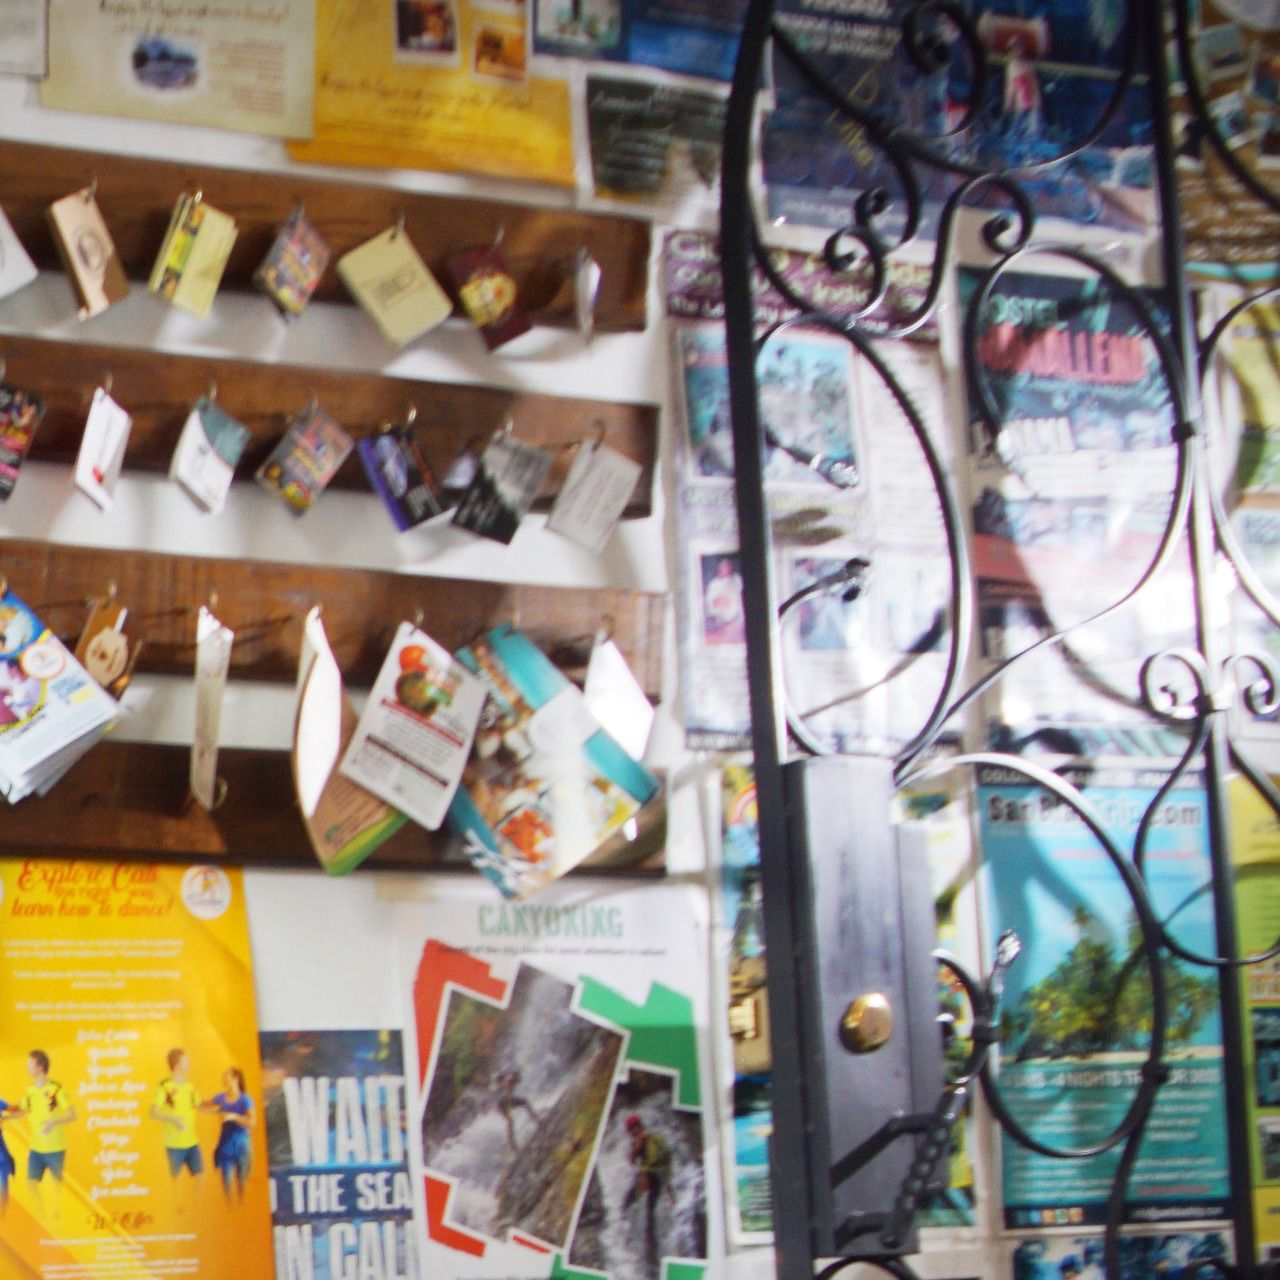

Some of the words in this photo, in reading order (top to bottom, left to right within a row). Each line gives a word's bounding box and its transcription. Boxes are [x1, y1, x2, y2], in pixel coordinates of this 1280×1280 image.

[477, 905, 625, 939] CANYONING
[283, 1075, 406, 1166] WAIT
[288, 1174, 348, 1214] THE
[355, 1172, 414, 1211] SEA
